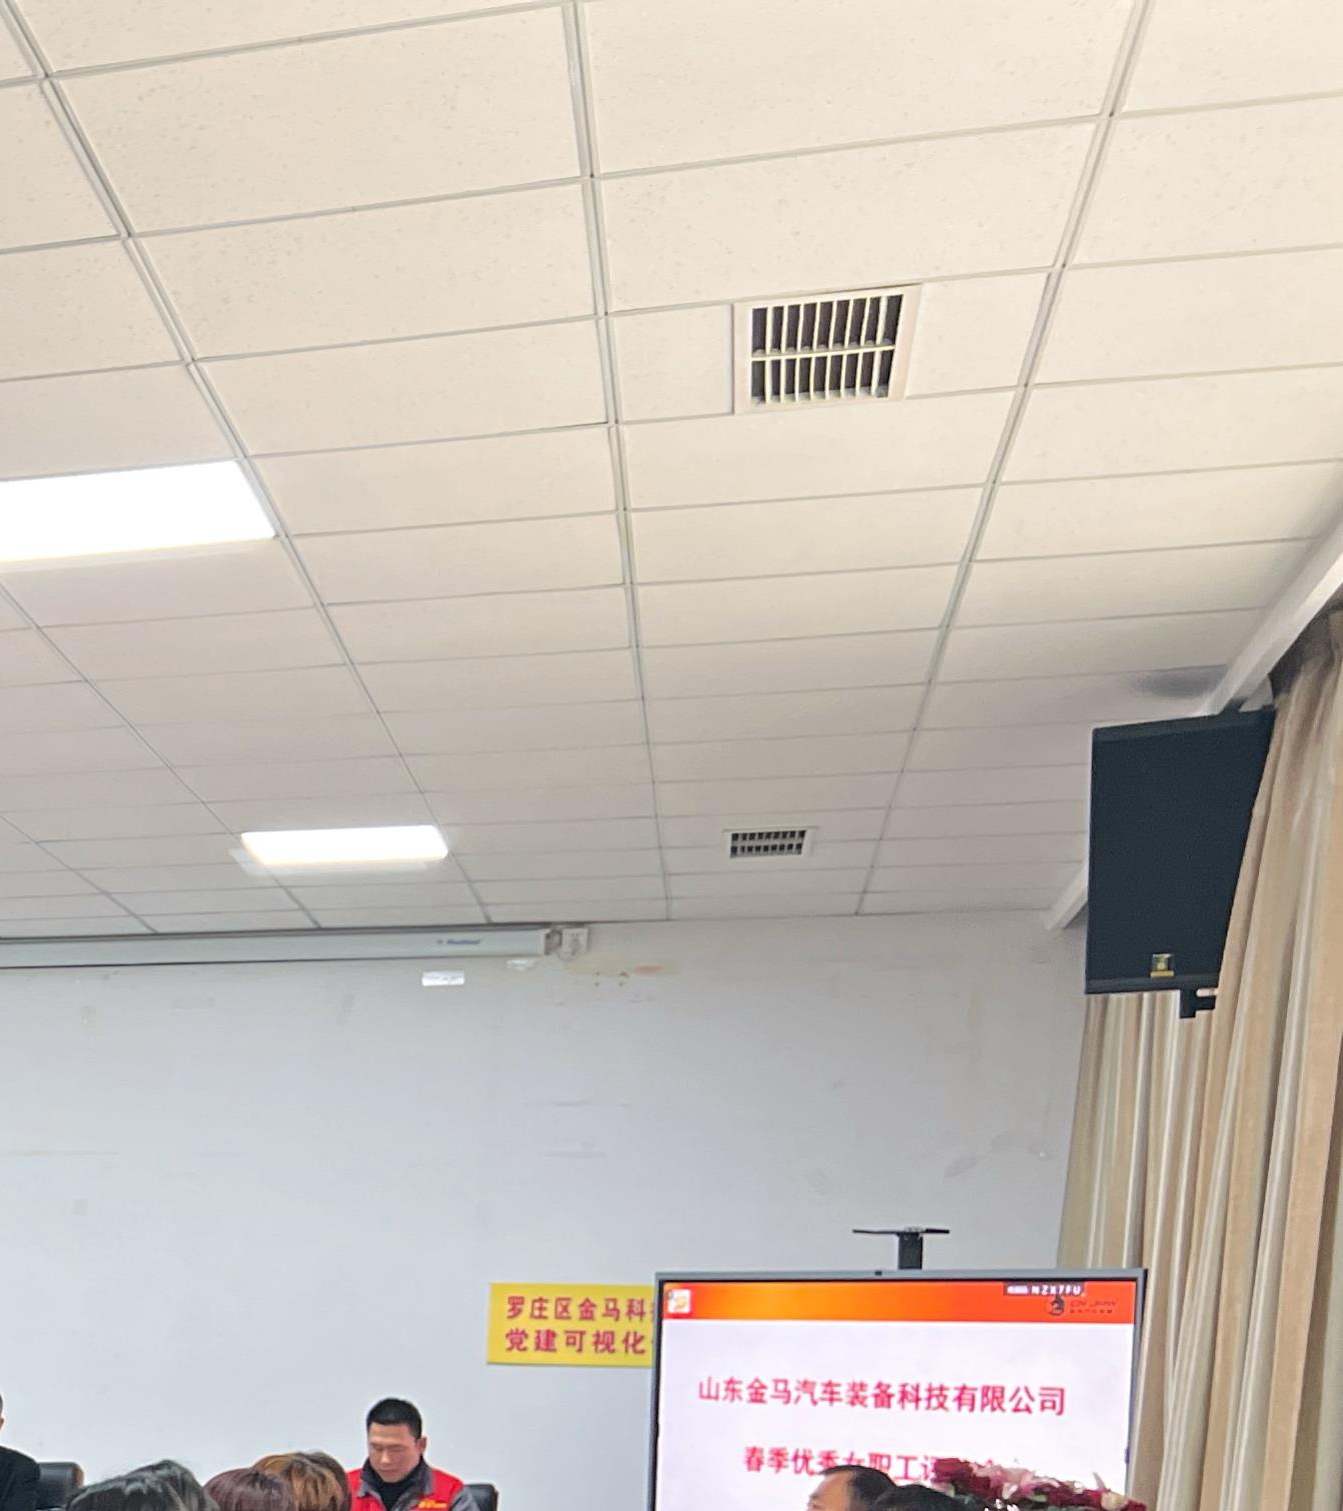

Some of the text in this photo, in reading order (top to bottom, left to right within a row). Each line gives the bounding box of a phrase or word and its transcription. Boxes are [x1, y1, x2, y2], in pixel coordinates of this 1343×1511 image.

[506, 1296, 654, 1322] 罗庄区金马科
[505, 1328, 654, 1354] 党建可视化
[698, 1376, 1065, 1416] 山东金马汽车装备科技有限公司
